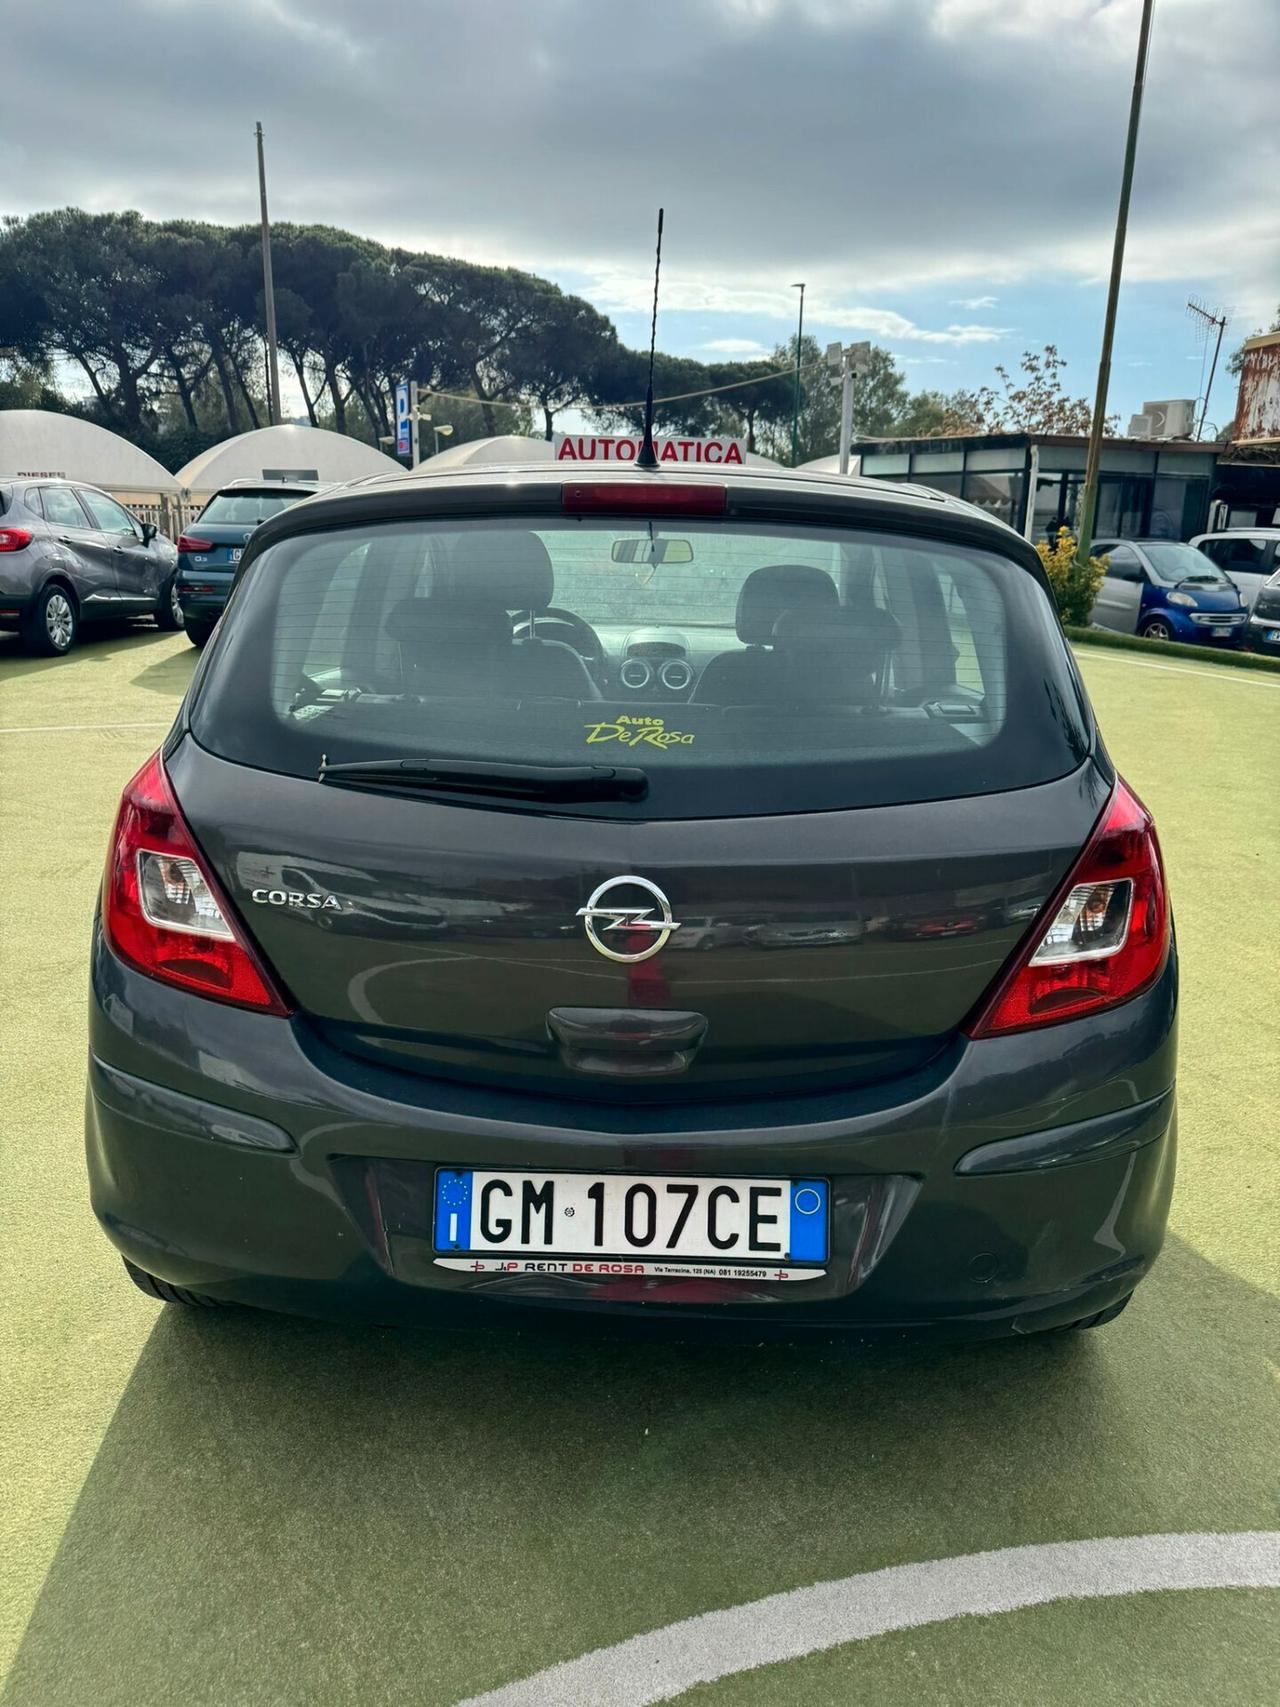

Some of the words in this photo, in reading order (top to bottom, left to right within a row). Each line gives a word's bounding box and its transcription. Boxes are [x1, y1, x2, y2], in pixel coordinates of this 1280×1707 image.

[615, 715, 665, 726] Auto
[251, 888, 343, 911] CORSA
[524, 1262, 568, 1272] RENT
[572, 1263, 594, 1273] DE
[598, 1263, 645, 1274] ROSA
[718, 1269, 731, 1277] 081
[734, 1270, 767, 1278] 19255479
